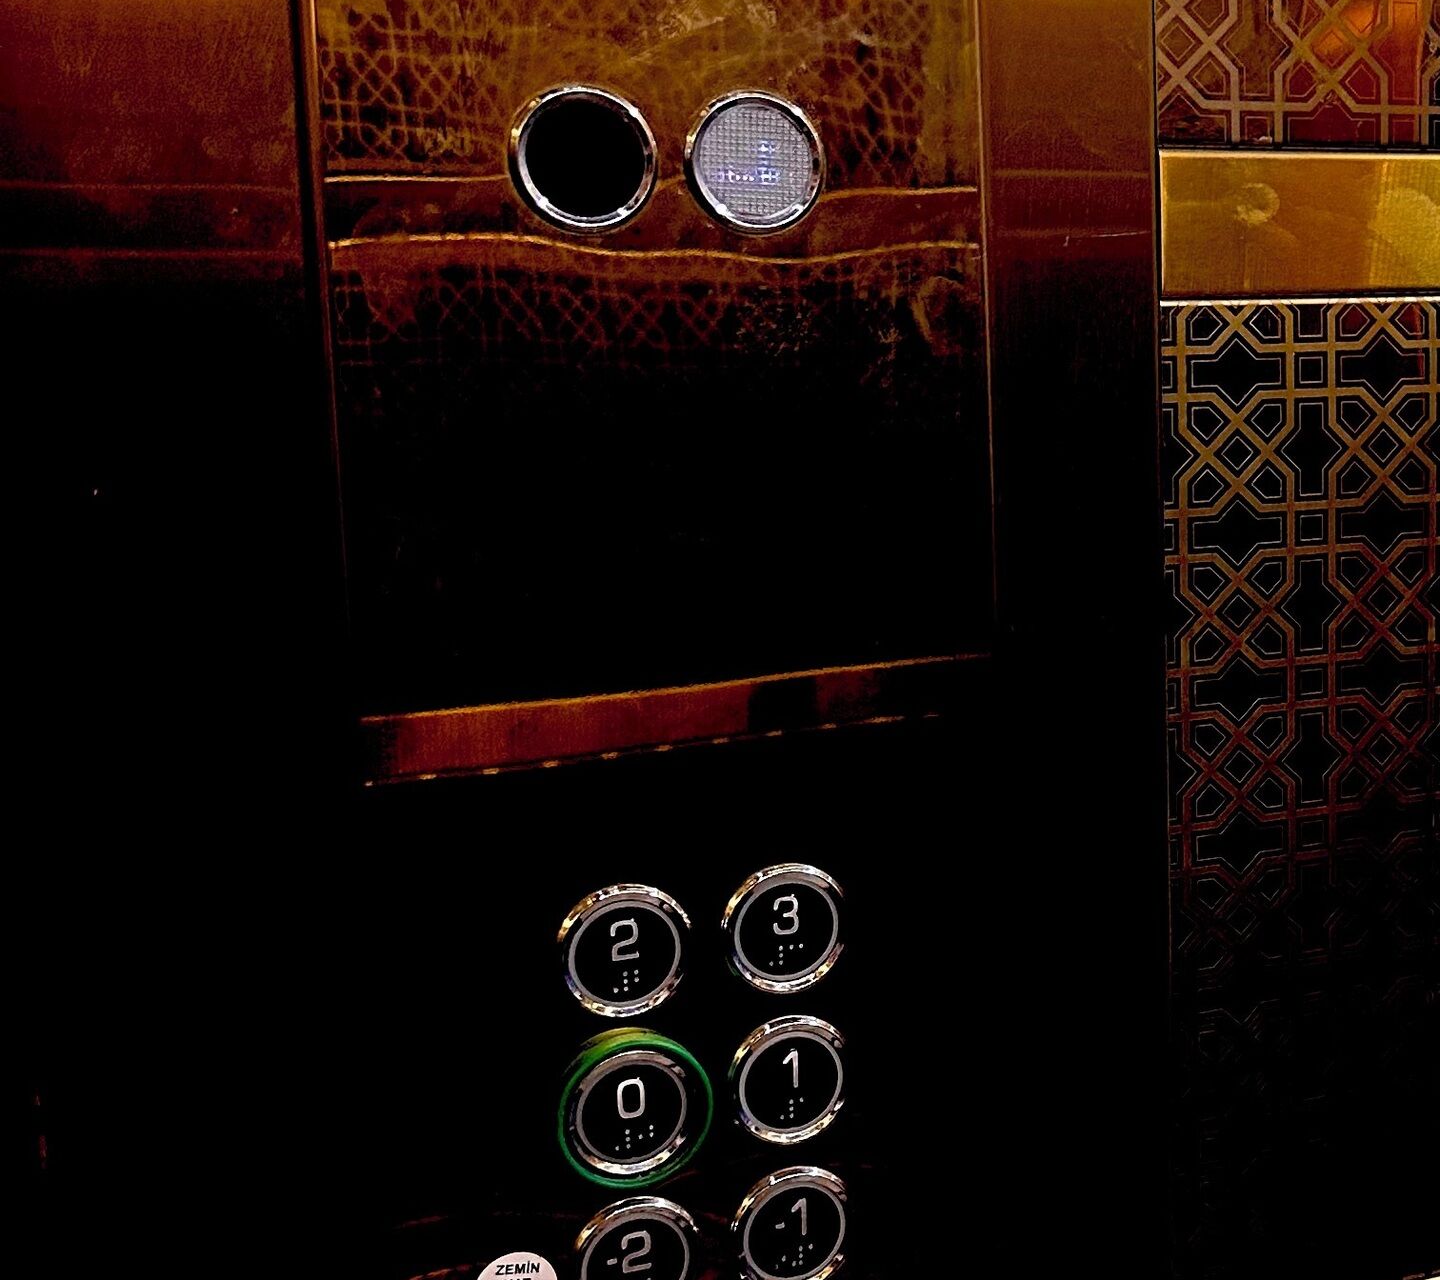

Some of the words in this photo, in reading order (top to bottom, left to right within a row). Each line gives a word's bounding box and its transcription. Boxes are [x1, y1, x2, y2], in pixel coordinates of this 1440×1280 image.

[772, 893, 800, 936] 3
[610, 918, 640, 962] 2
[782, 1048, 801, 1089] 1
[616, 1077, 646, 1118] 0
[775, 1197, 808, 1236] -1
[495, 1261, 541, 1277] ZEMİN
[607, 1230, 653, 1276] -2
